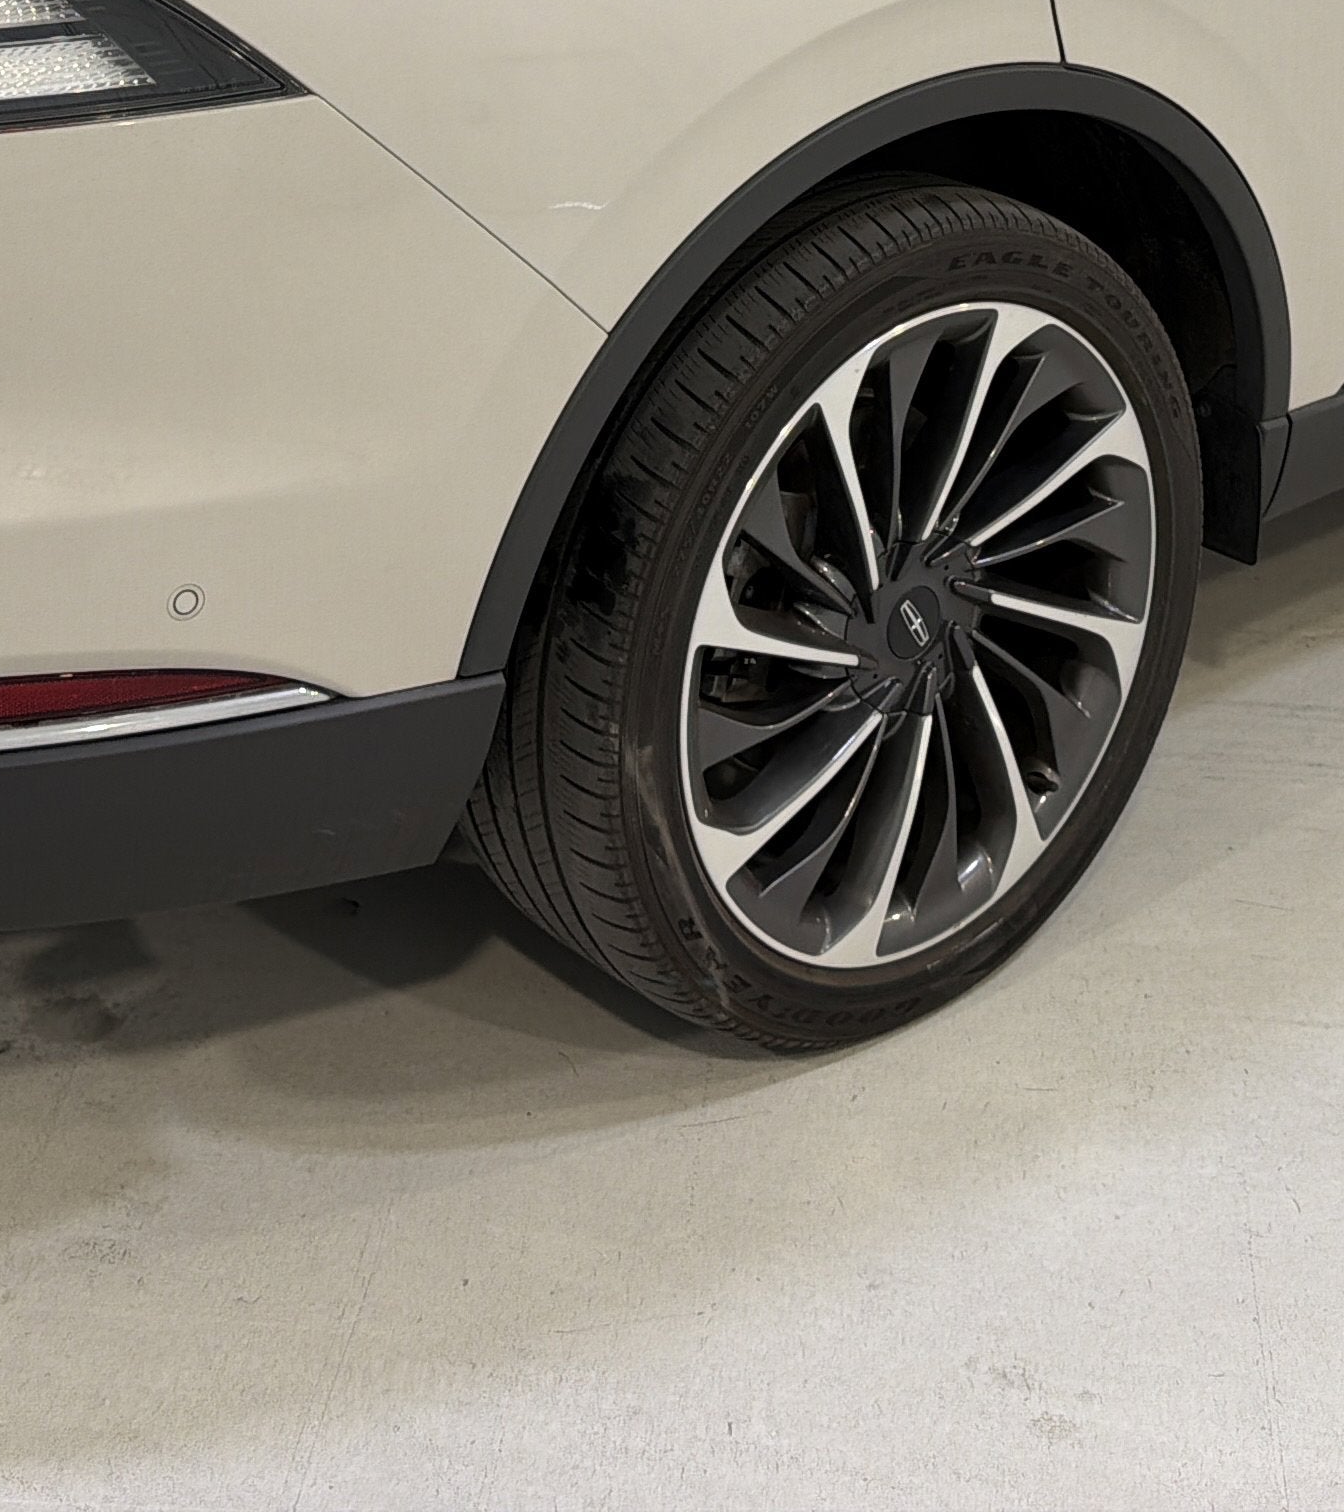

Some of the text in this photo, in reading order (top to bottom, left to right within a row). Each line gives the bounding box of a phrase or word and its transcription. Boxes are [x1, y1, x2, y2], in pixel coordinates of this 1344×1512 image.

[947, 250, 1182, 420] EAGLE TOURING
[676, 915, 923, 1027] GOODYEAR
